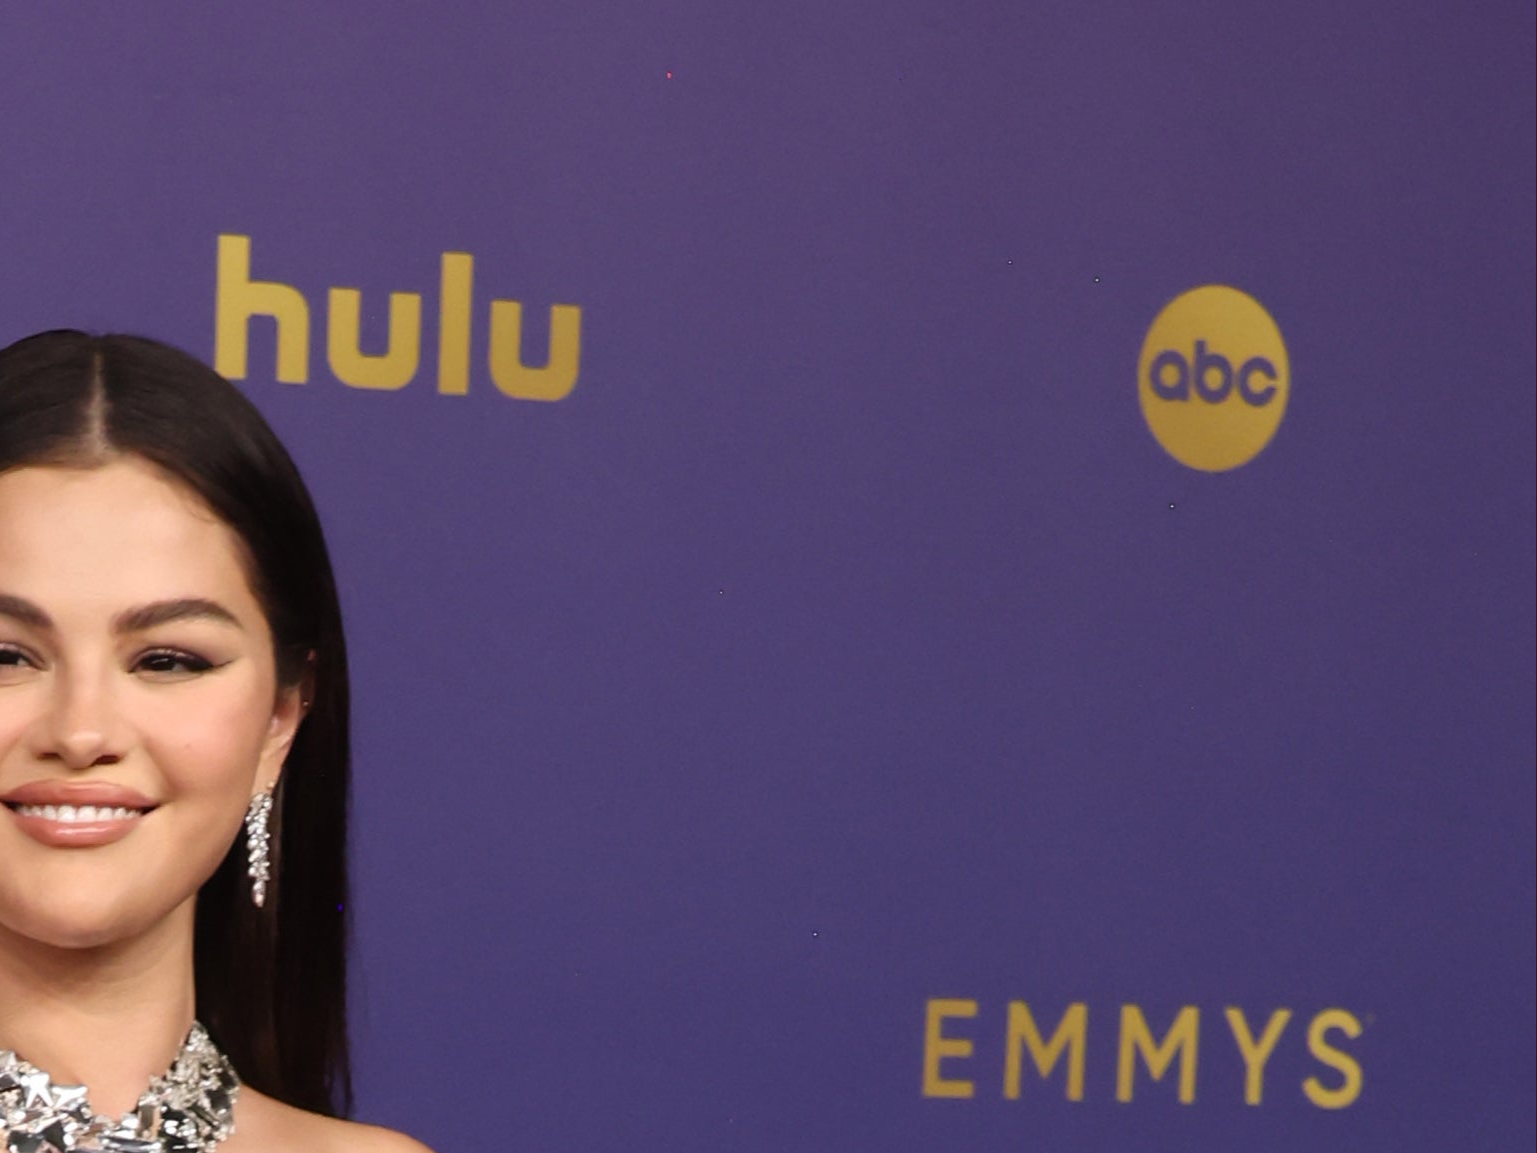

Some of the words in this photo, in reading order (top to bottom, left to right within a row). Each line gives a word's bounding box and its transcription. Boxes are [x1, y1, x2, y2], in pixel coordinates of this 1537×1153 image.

[215, 234, 582, 402] hulu
[1150, 339, 1278, 408] abc
[922, 998, 1363, 1110] EMMYS
